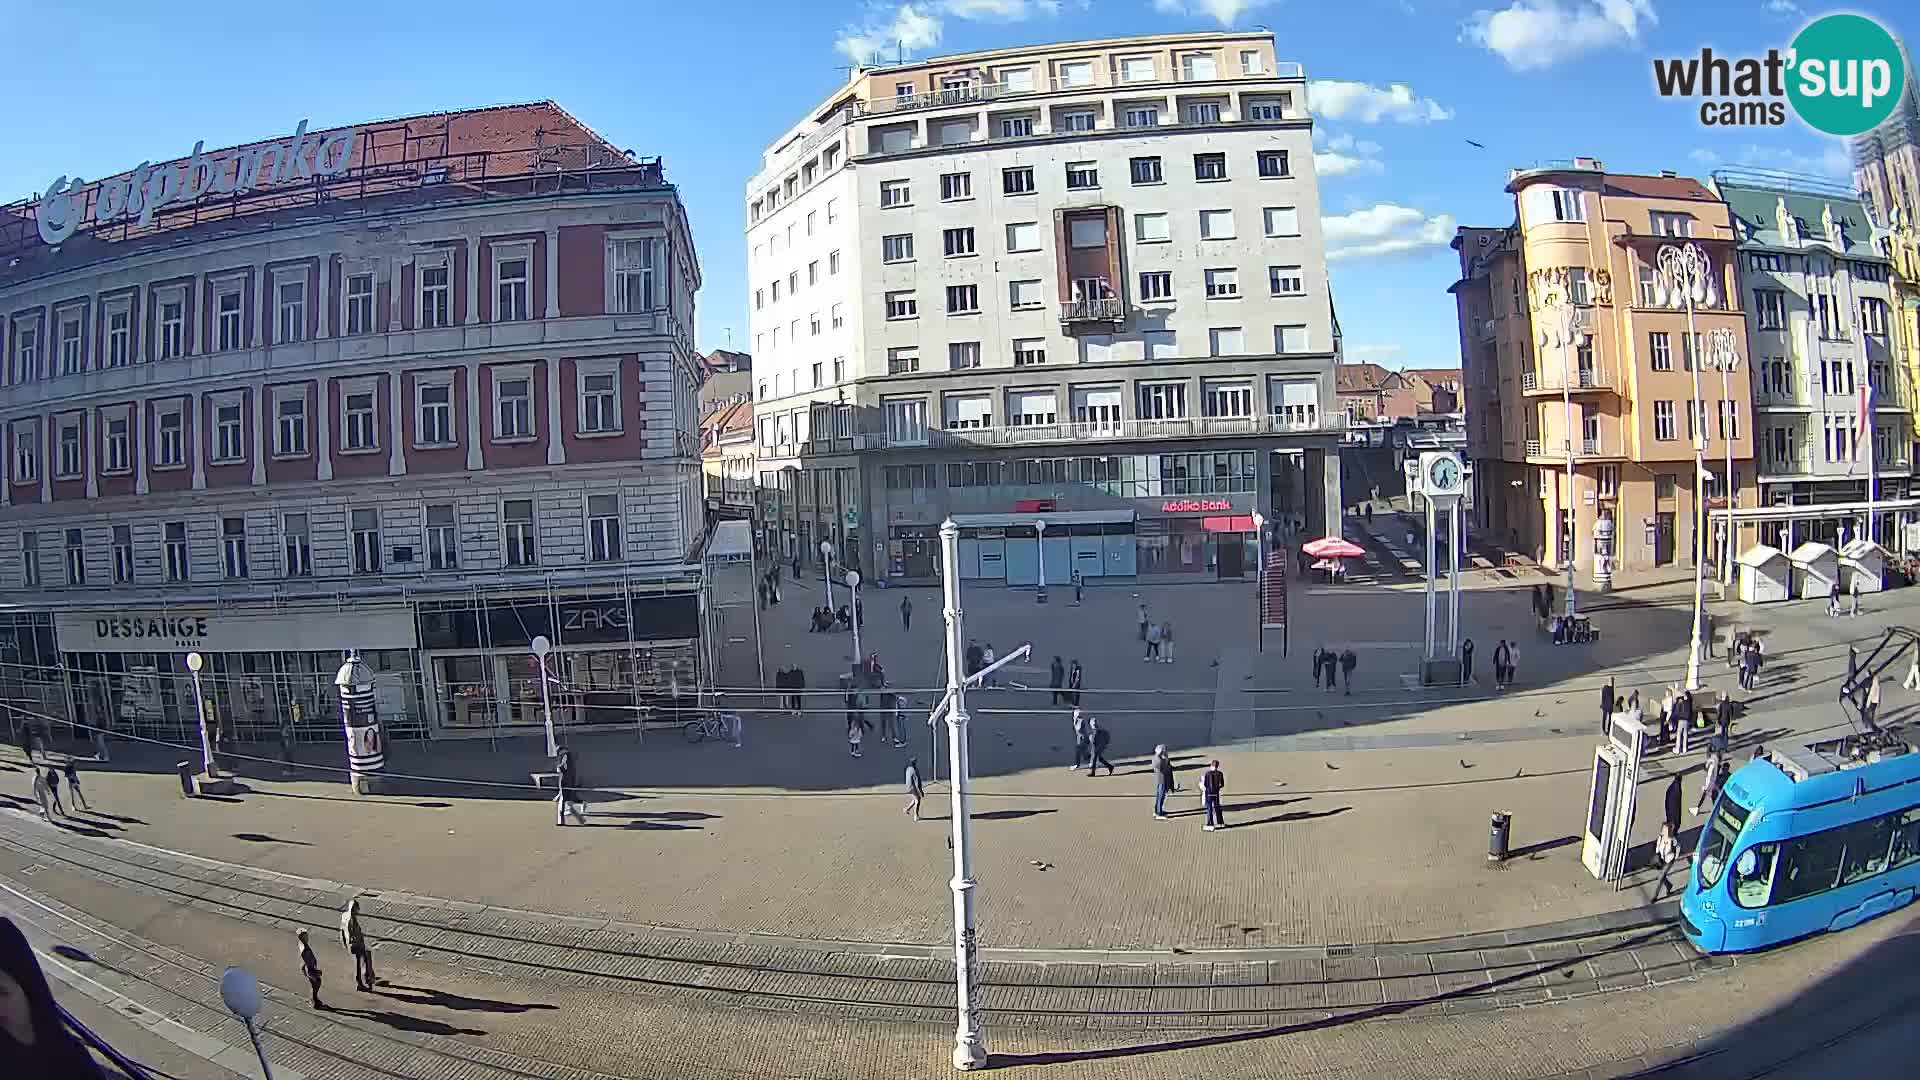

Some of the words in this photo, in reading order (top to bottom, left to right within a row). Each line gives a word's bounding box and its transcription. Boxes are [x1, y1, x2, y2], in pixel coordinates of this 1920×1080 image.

[1162, 500, 1200, 512] Addiko
[1201, 498, 1232, 511] Bank
[96, 617, 208, 638] DESSANGE
